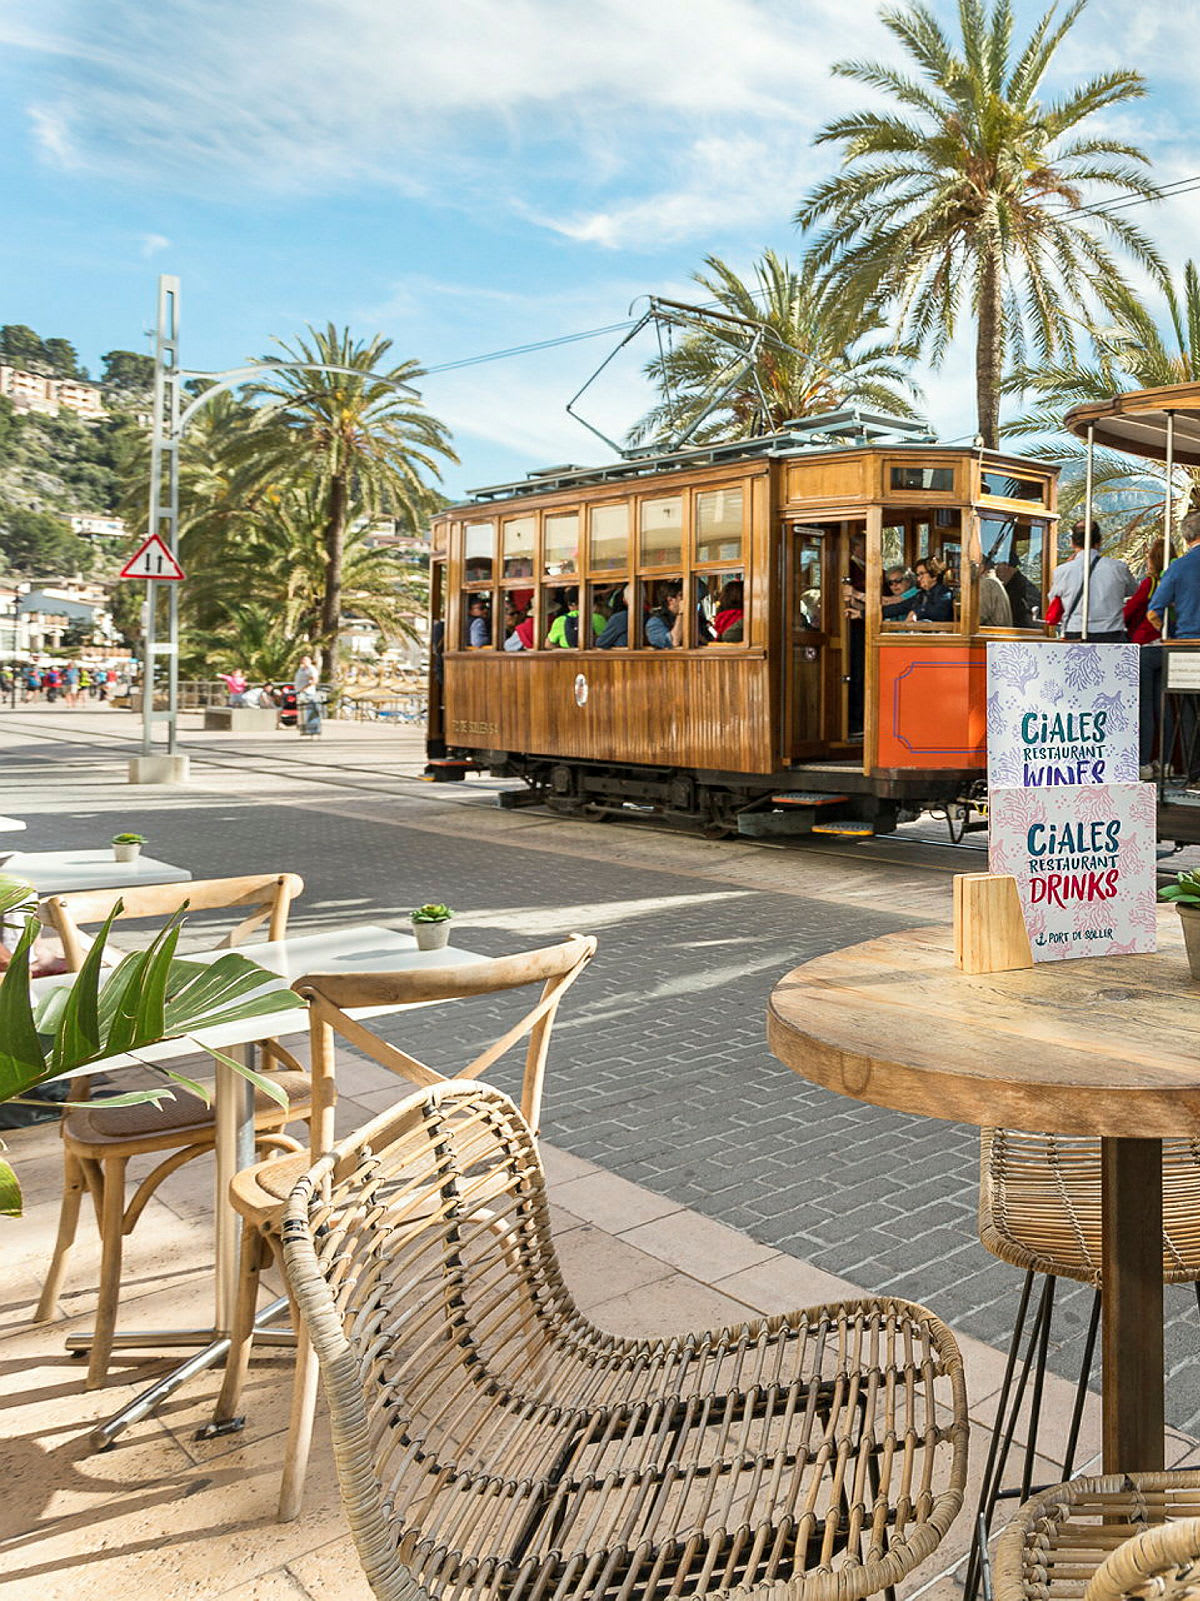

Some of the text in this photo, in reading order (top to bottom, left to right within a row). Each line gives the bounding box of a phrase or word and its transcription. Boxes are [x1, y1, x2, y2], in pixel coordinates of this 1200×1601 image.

[1023, 745, 1106, 761] RESTAURANT
[1023, 760, 1106, 787] WINES
[1028, 855, 1119, 873] RESTAURANT
[1028, 869, 1119, 910] DRINKS
[1048, 932, 1069, 944] PORT
[1072, 931, 1082, 941] DE
